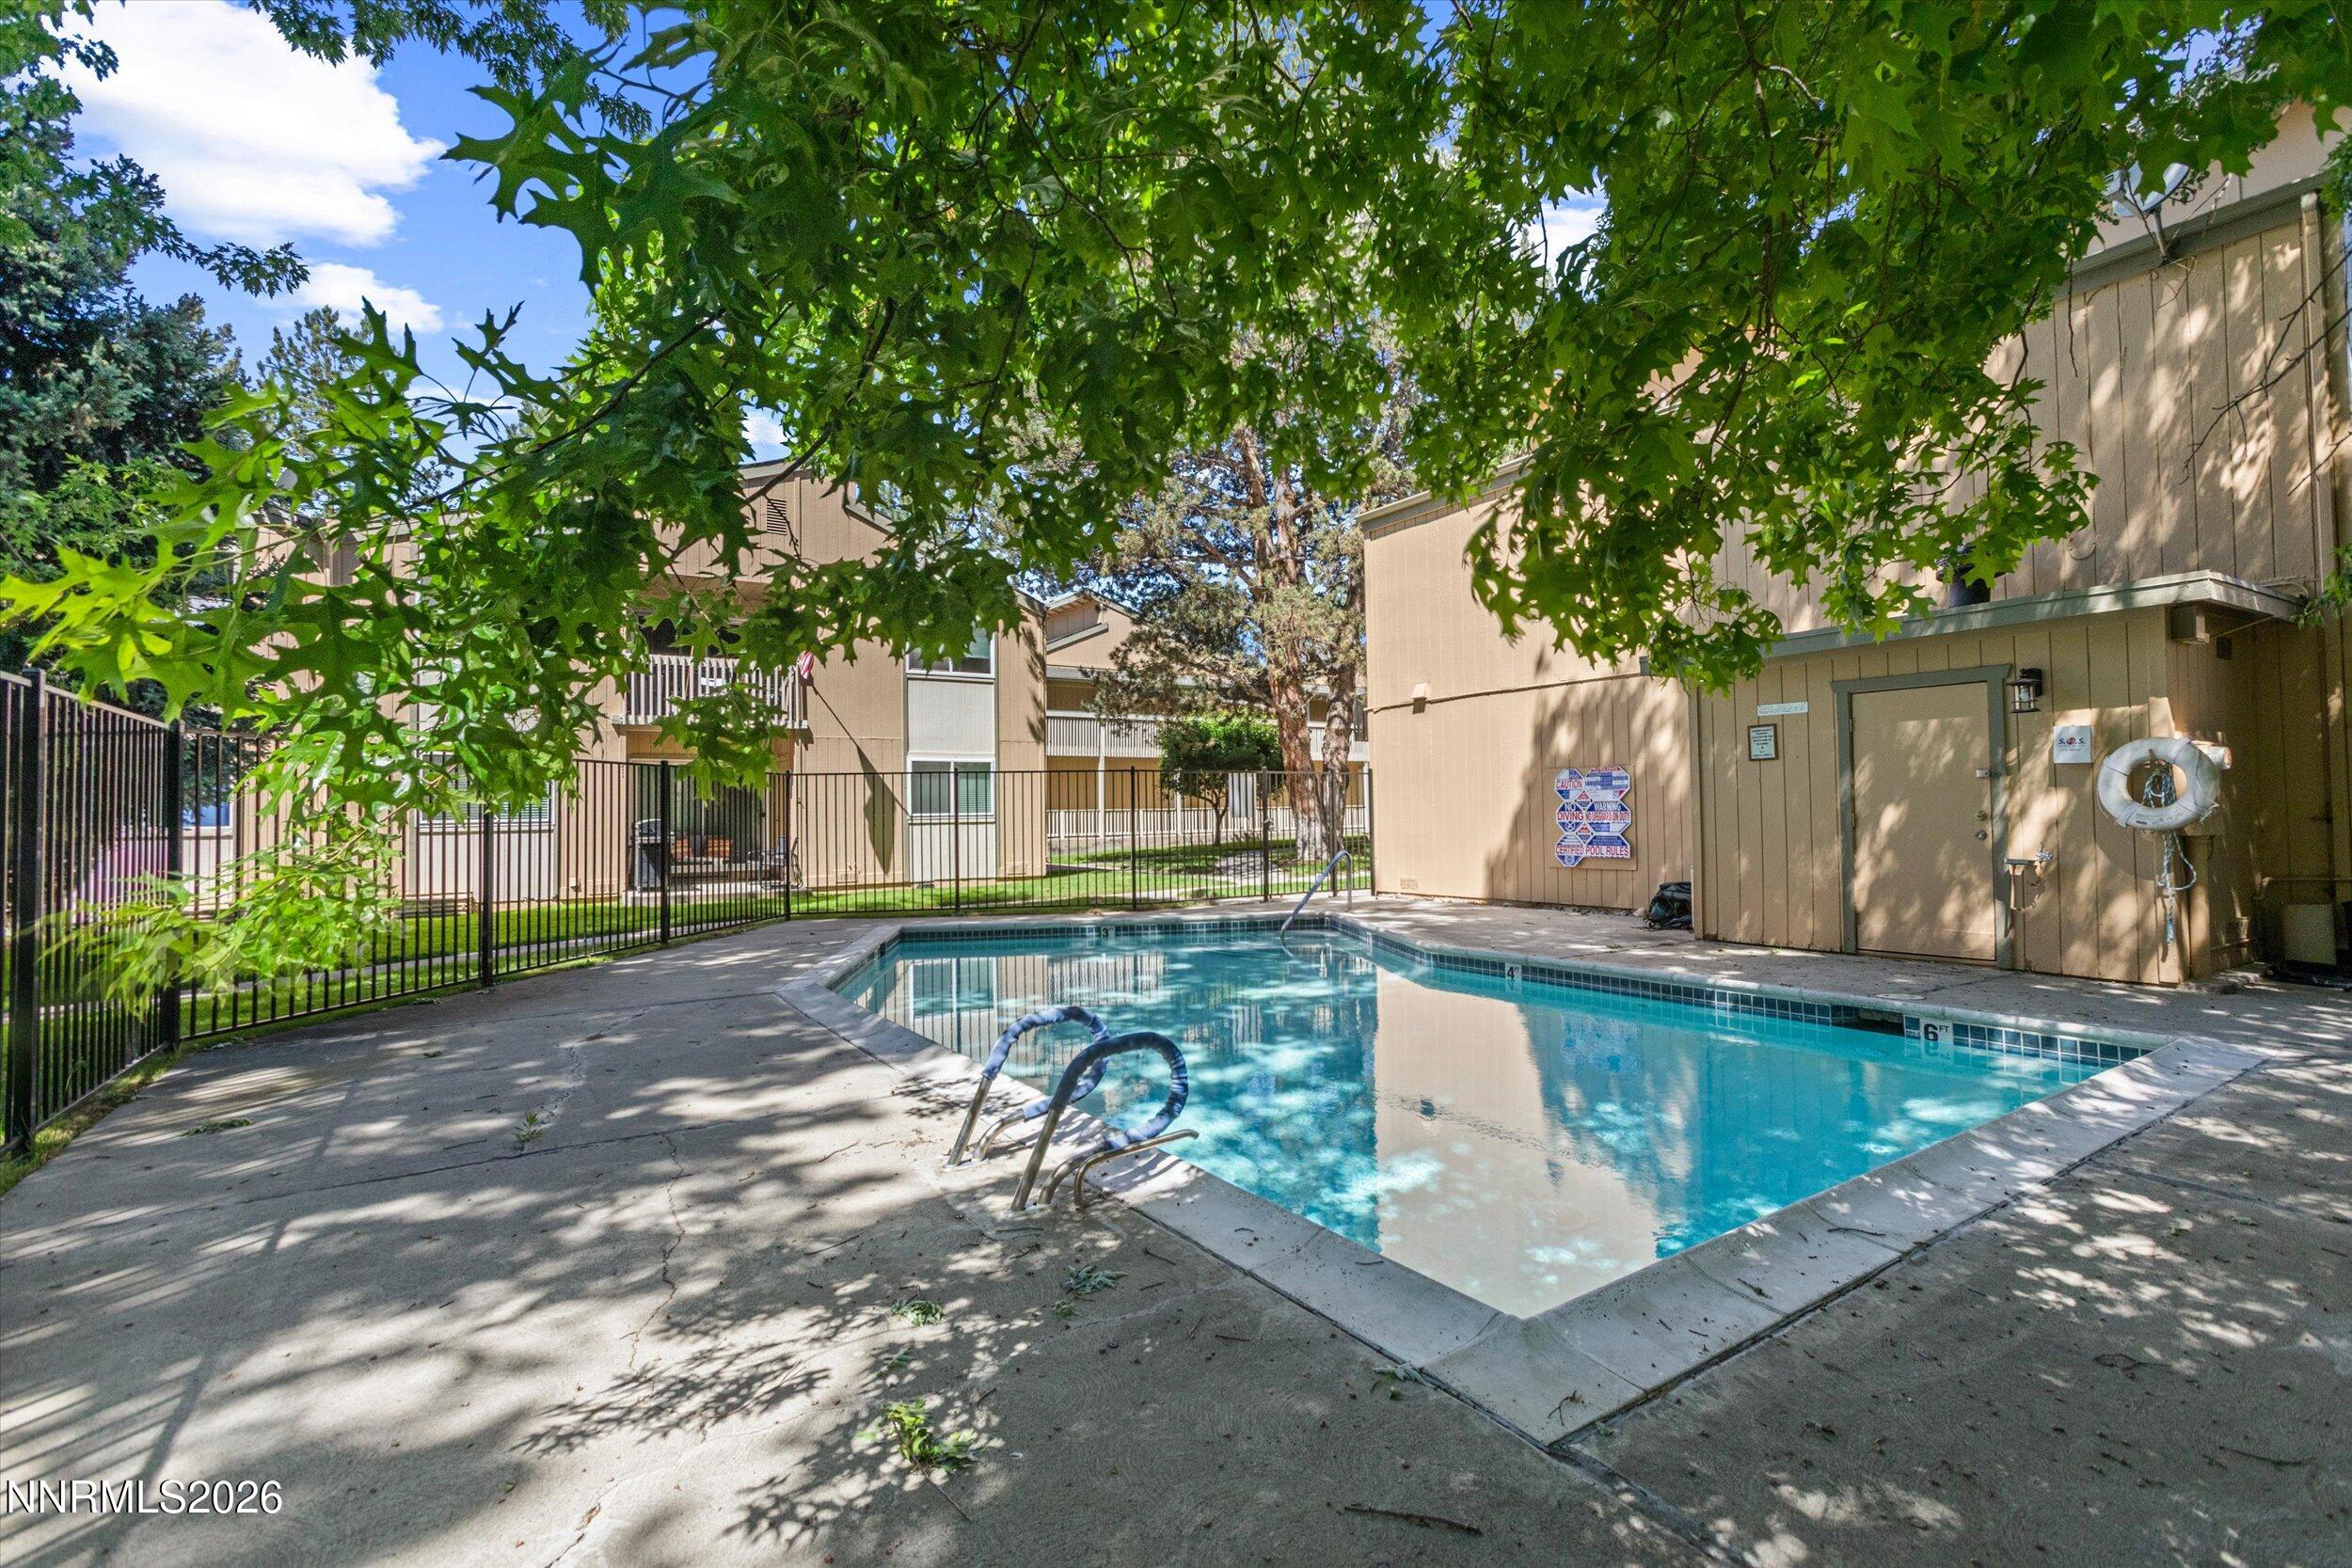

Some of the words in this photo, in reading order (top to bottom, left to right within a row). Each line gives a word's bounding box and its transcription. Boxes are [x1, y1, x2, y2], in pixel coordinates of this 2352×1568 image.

[1556, 779, 1582, 789] CAUTION
[1565, 801, 1576, 811] NO
[1595, 801, 1621, 811] WARNING
[1558, 811, 1583, 820] DIVING
[1613, 812, 1618, 821] ON
[1619, 812, 1629, 821] DUTY
[1556, 845, 1583, 855] CERTIFIED
[1586, 846, 1604, 855] POOL
[1606, 846, 1629, 856] RULES
[1103, 927, 1108, 937] 3
[1507, 966, 1515, 979] 4
[1924, 1023, 1938, 1041] 6
